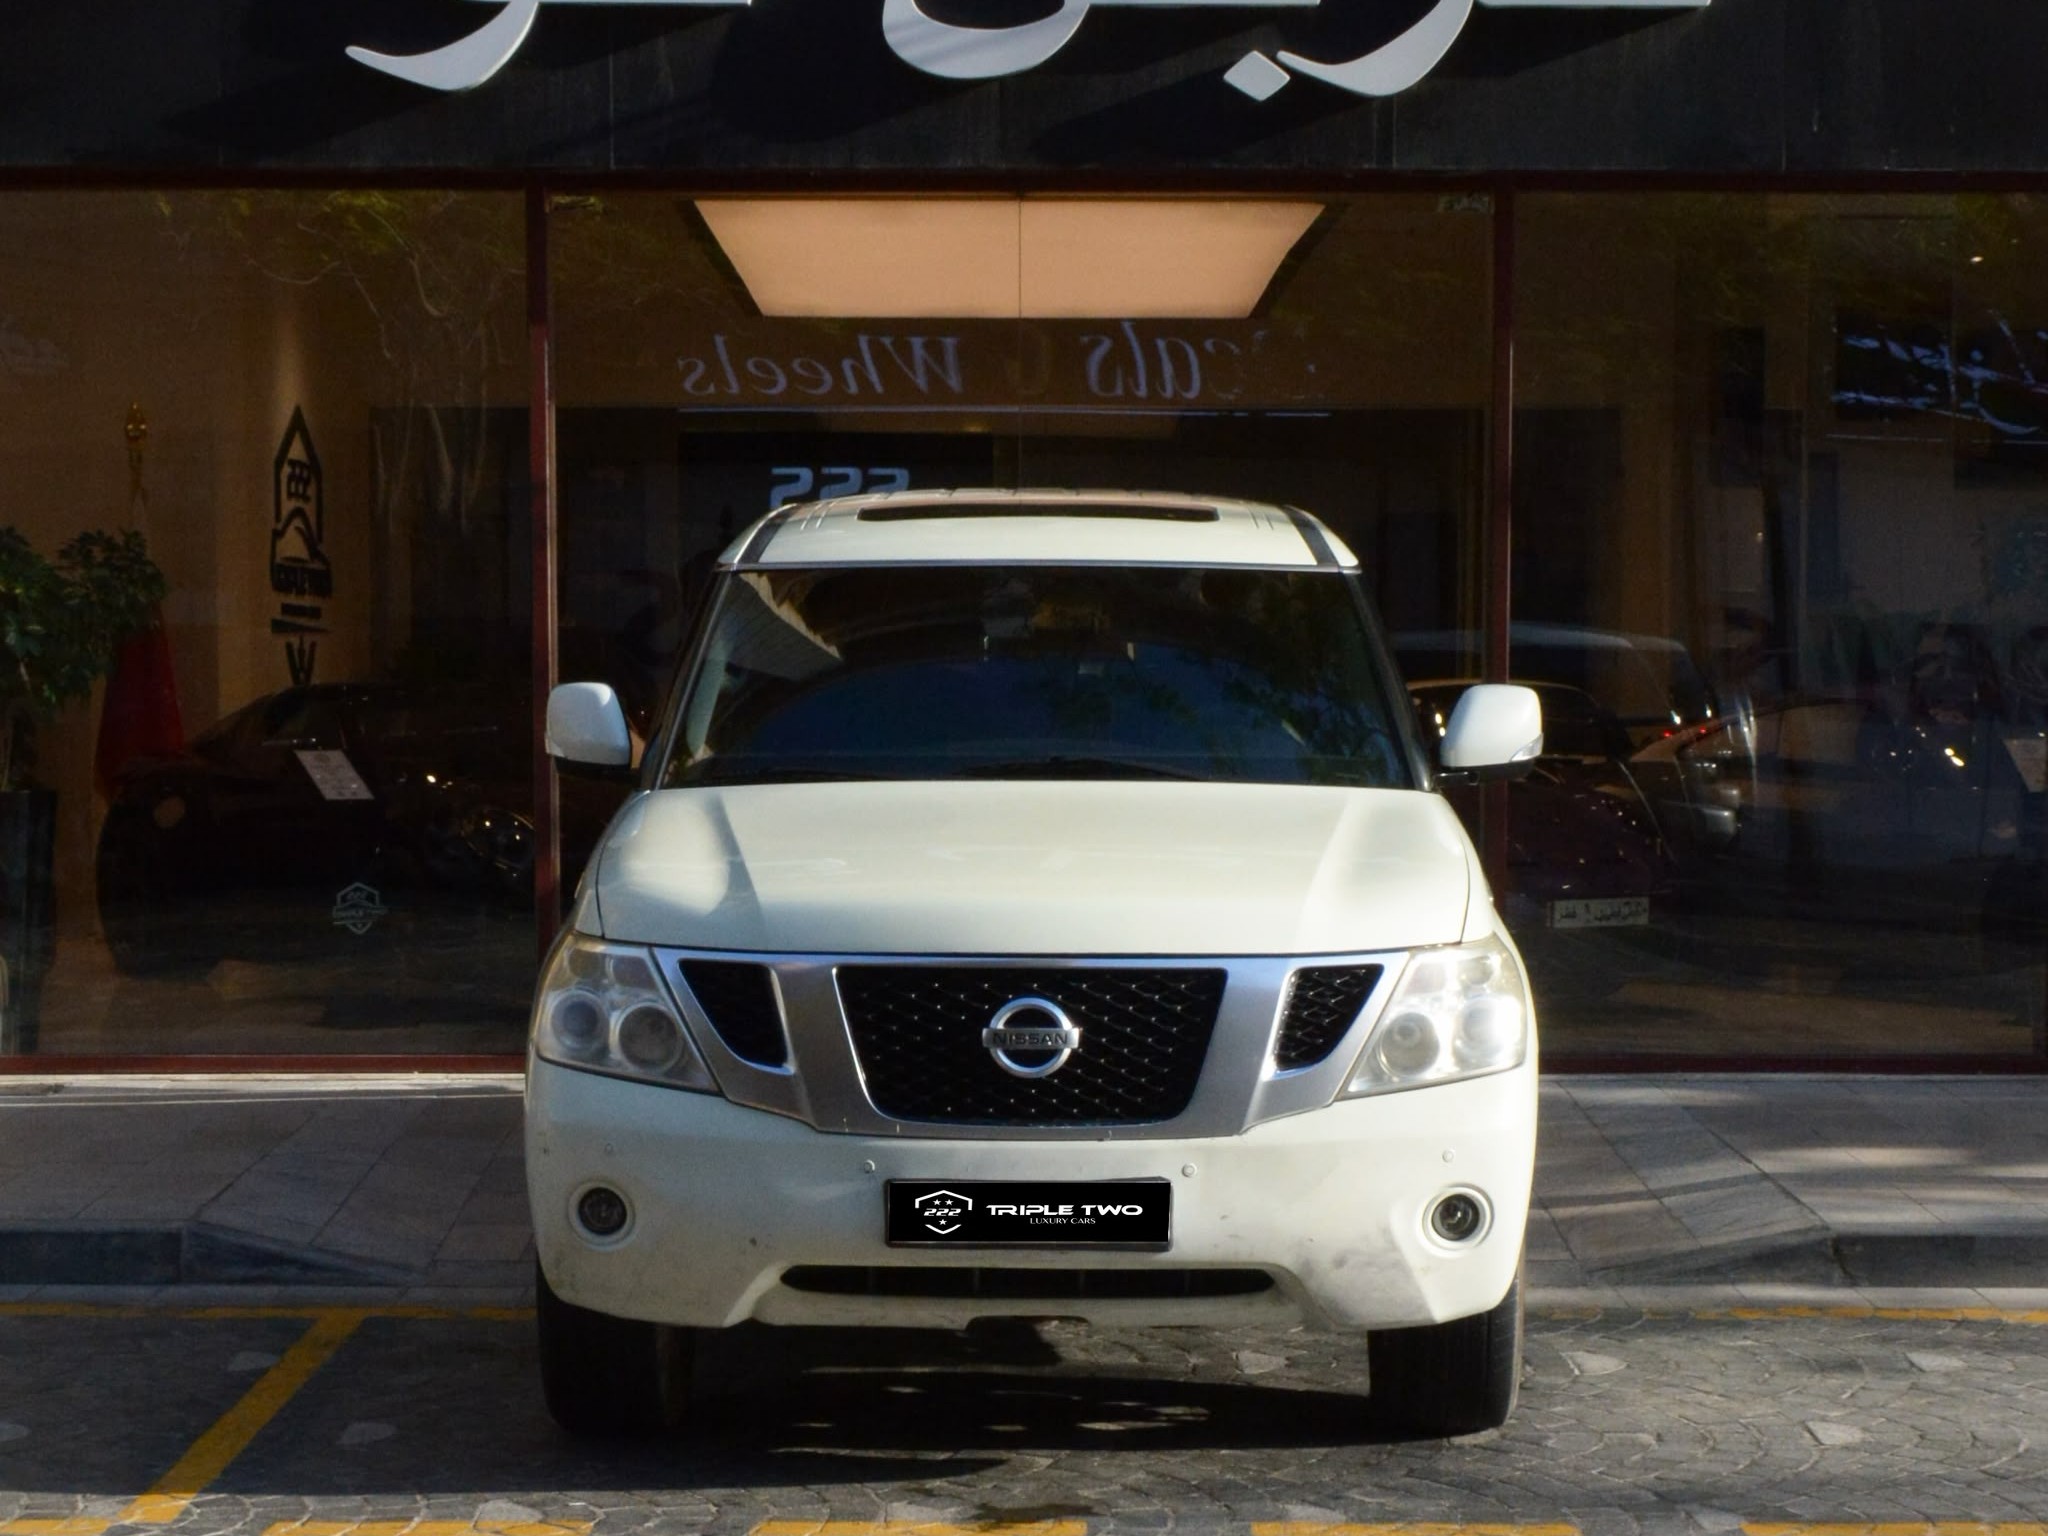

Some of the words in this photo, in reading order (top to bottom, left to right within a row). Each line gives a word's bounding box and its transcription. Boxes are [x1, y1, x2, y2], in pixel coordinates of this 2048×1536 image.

[993, 1032, 1068, 1046] NISSAN
[923, 1208, 962, 1217] 222
[985, 1204, 1075, 1216] TRIPLE
[1080, 1204, 1144, 1216] TWO
[1029, 1217, 1069, 1225] LUXURY
[1070, 1217, 1096, 1225] CARS
